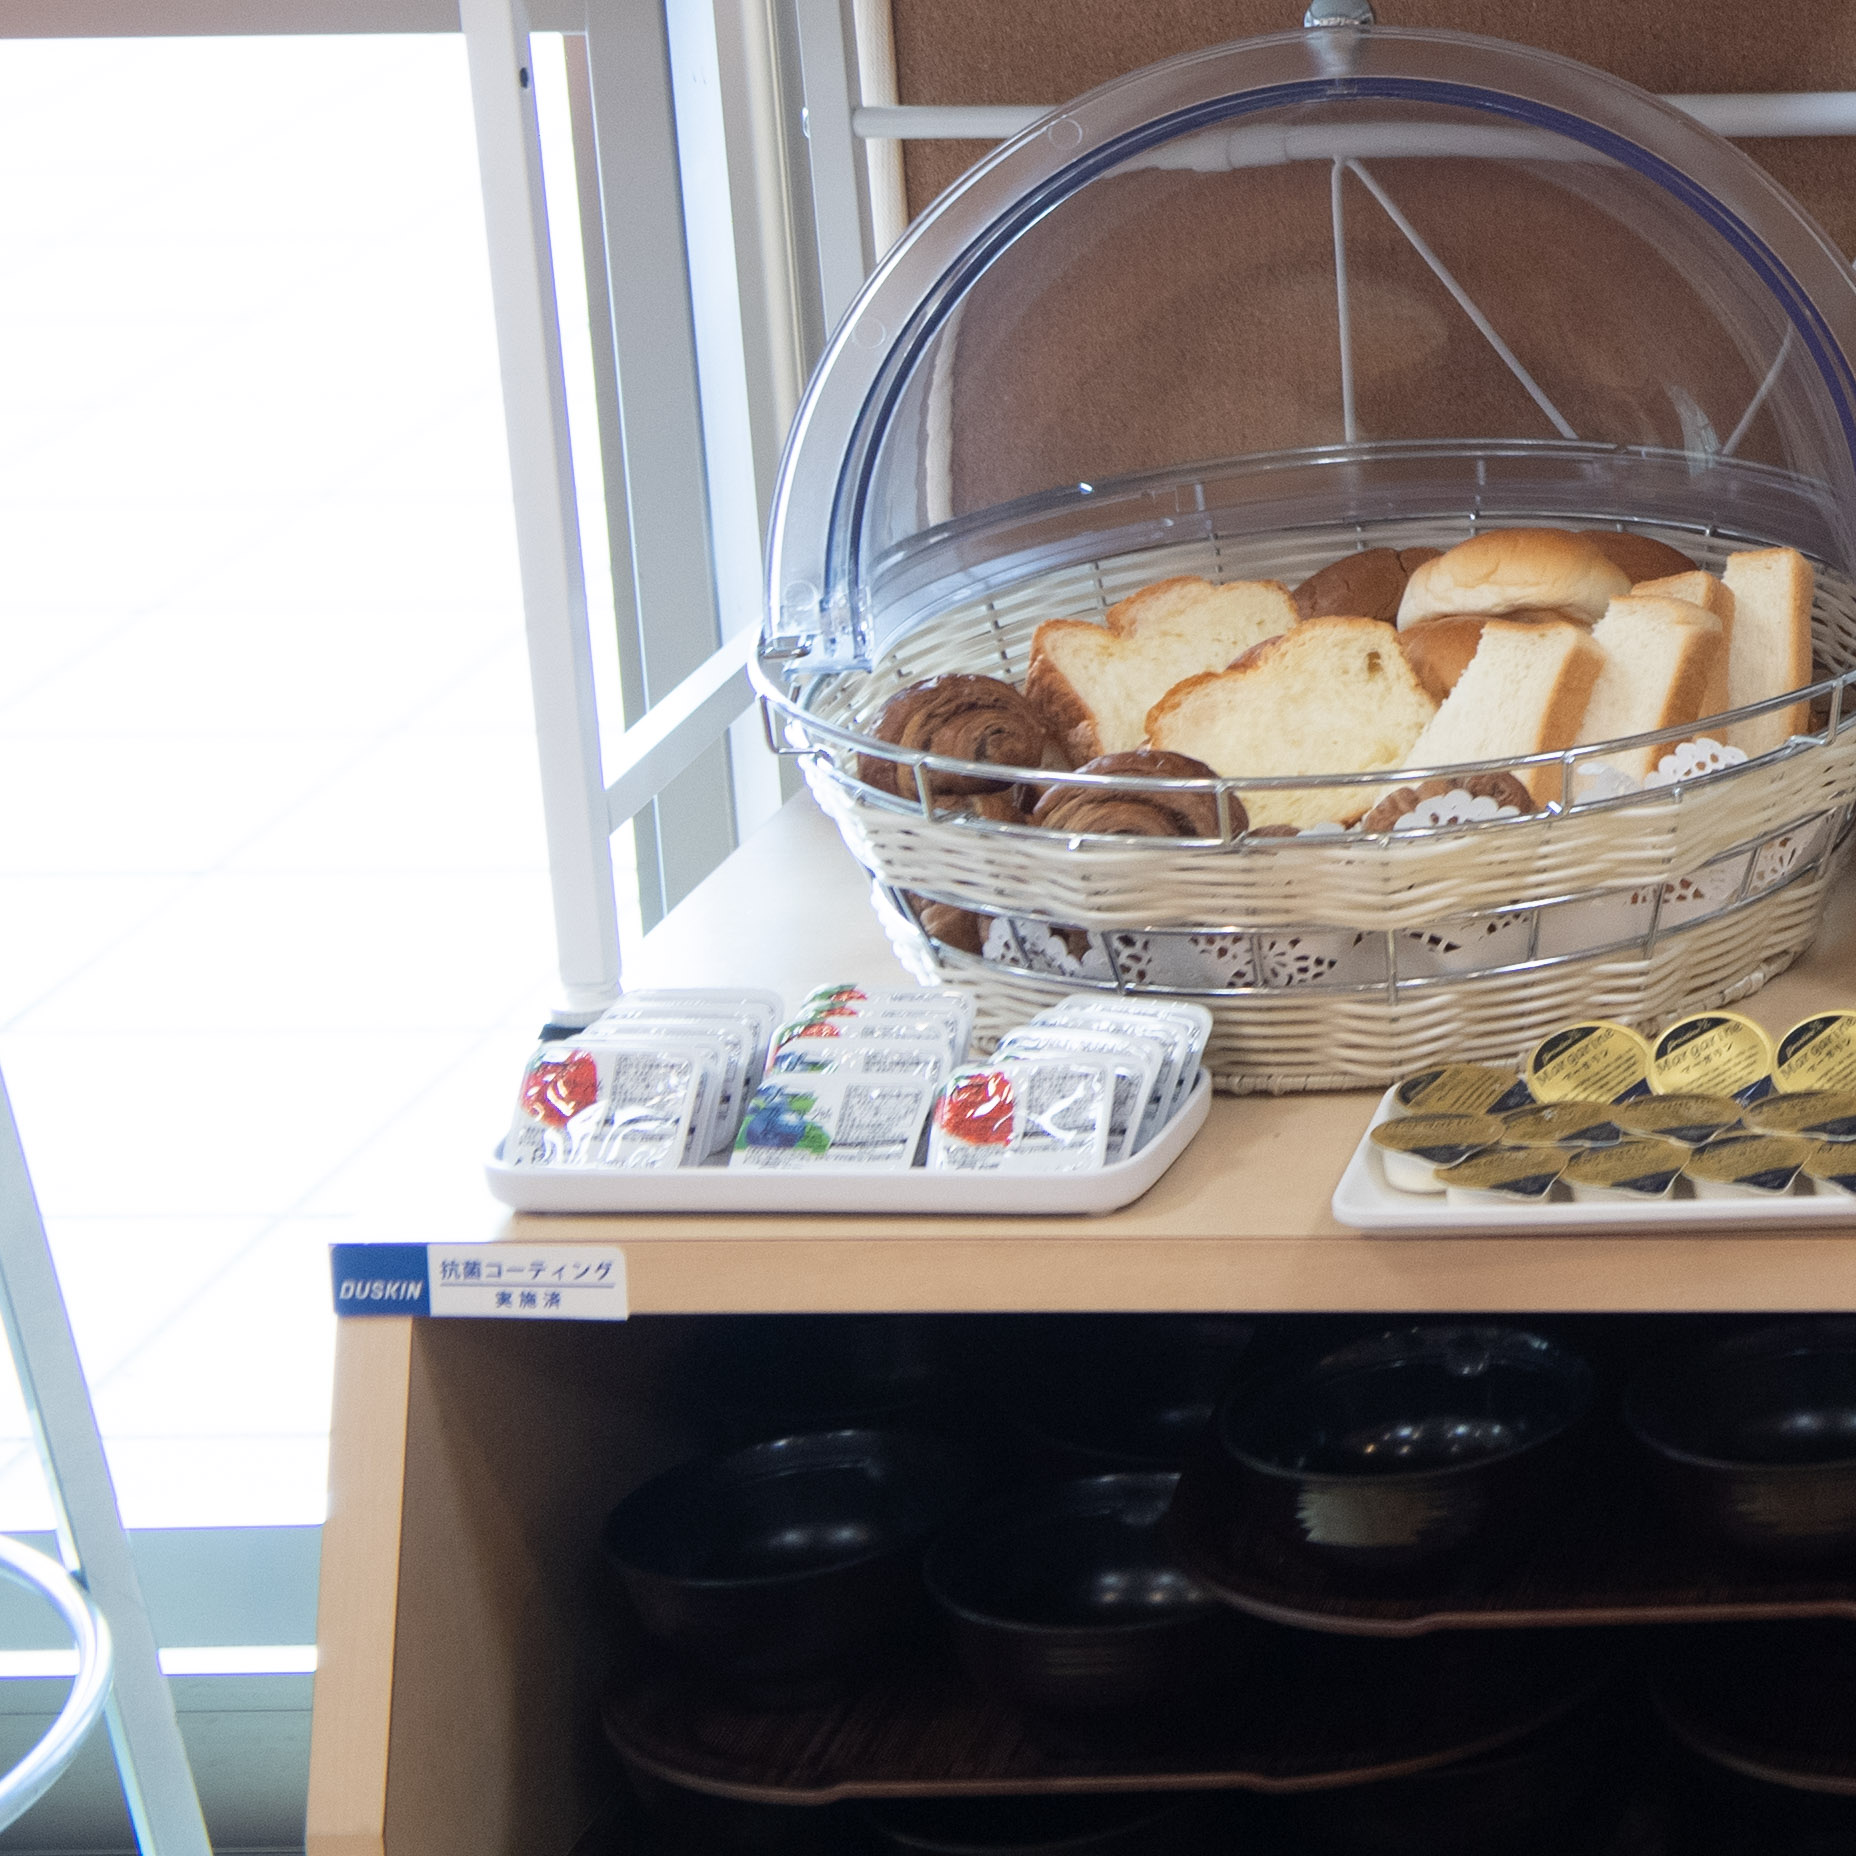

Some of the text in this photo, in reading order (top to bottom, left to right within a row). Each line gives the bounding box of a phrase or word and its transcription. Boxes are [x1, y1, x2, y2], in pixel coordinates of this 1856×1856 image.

[440, 1258, 613, 1282] 抗菌コーティング
[339, 1279, 424, 1301] DUSKIN
[495, 1290, 563, 1310] 実施済
